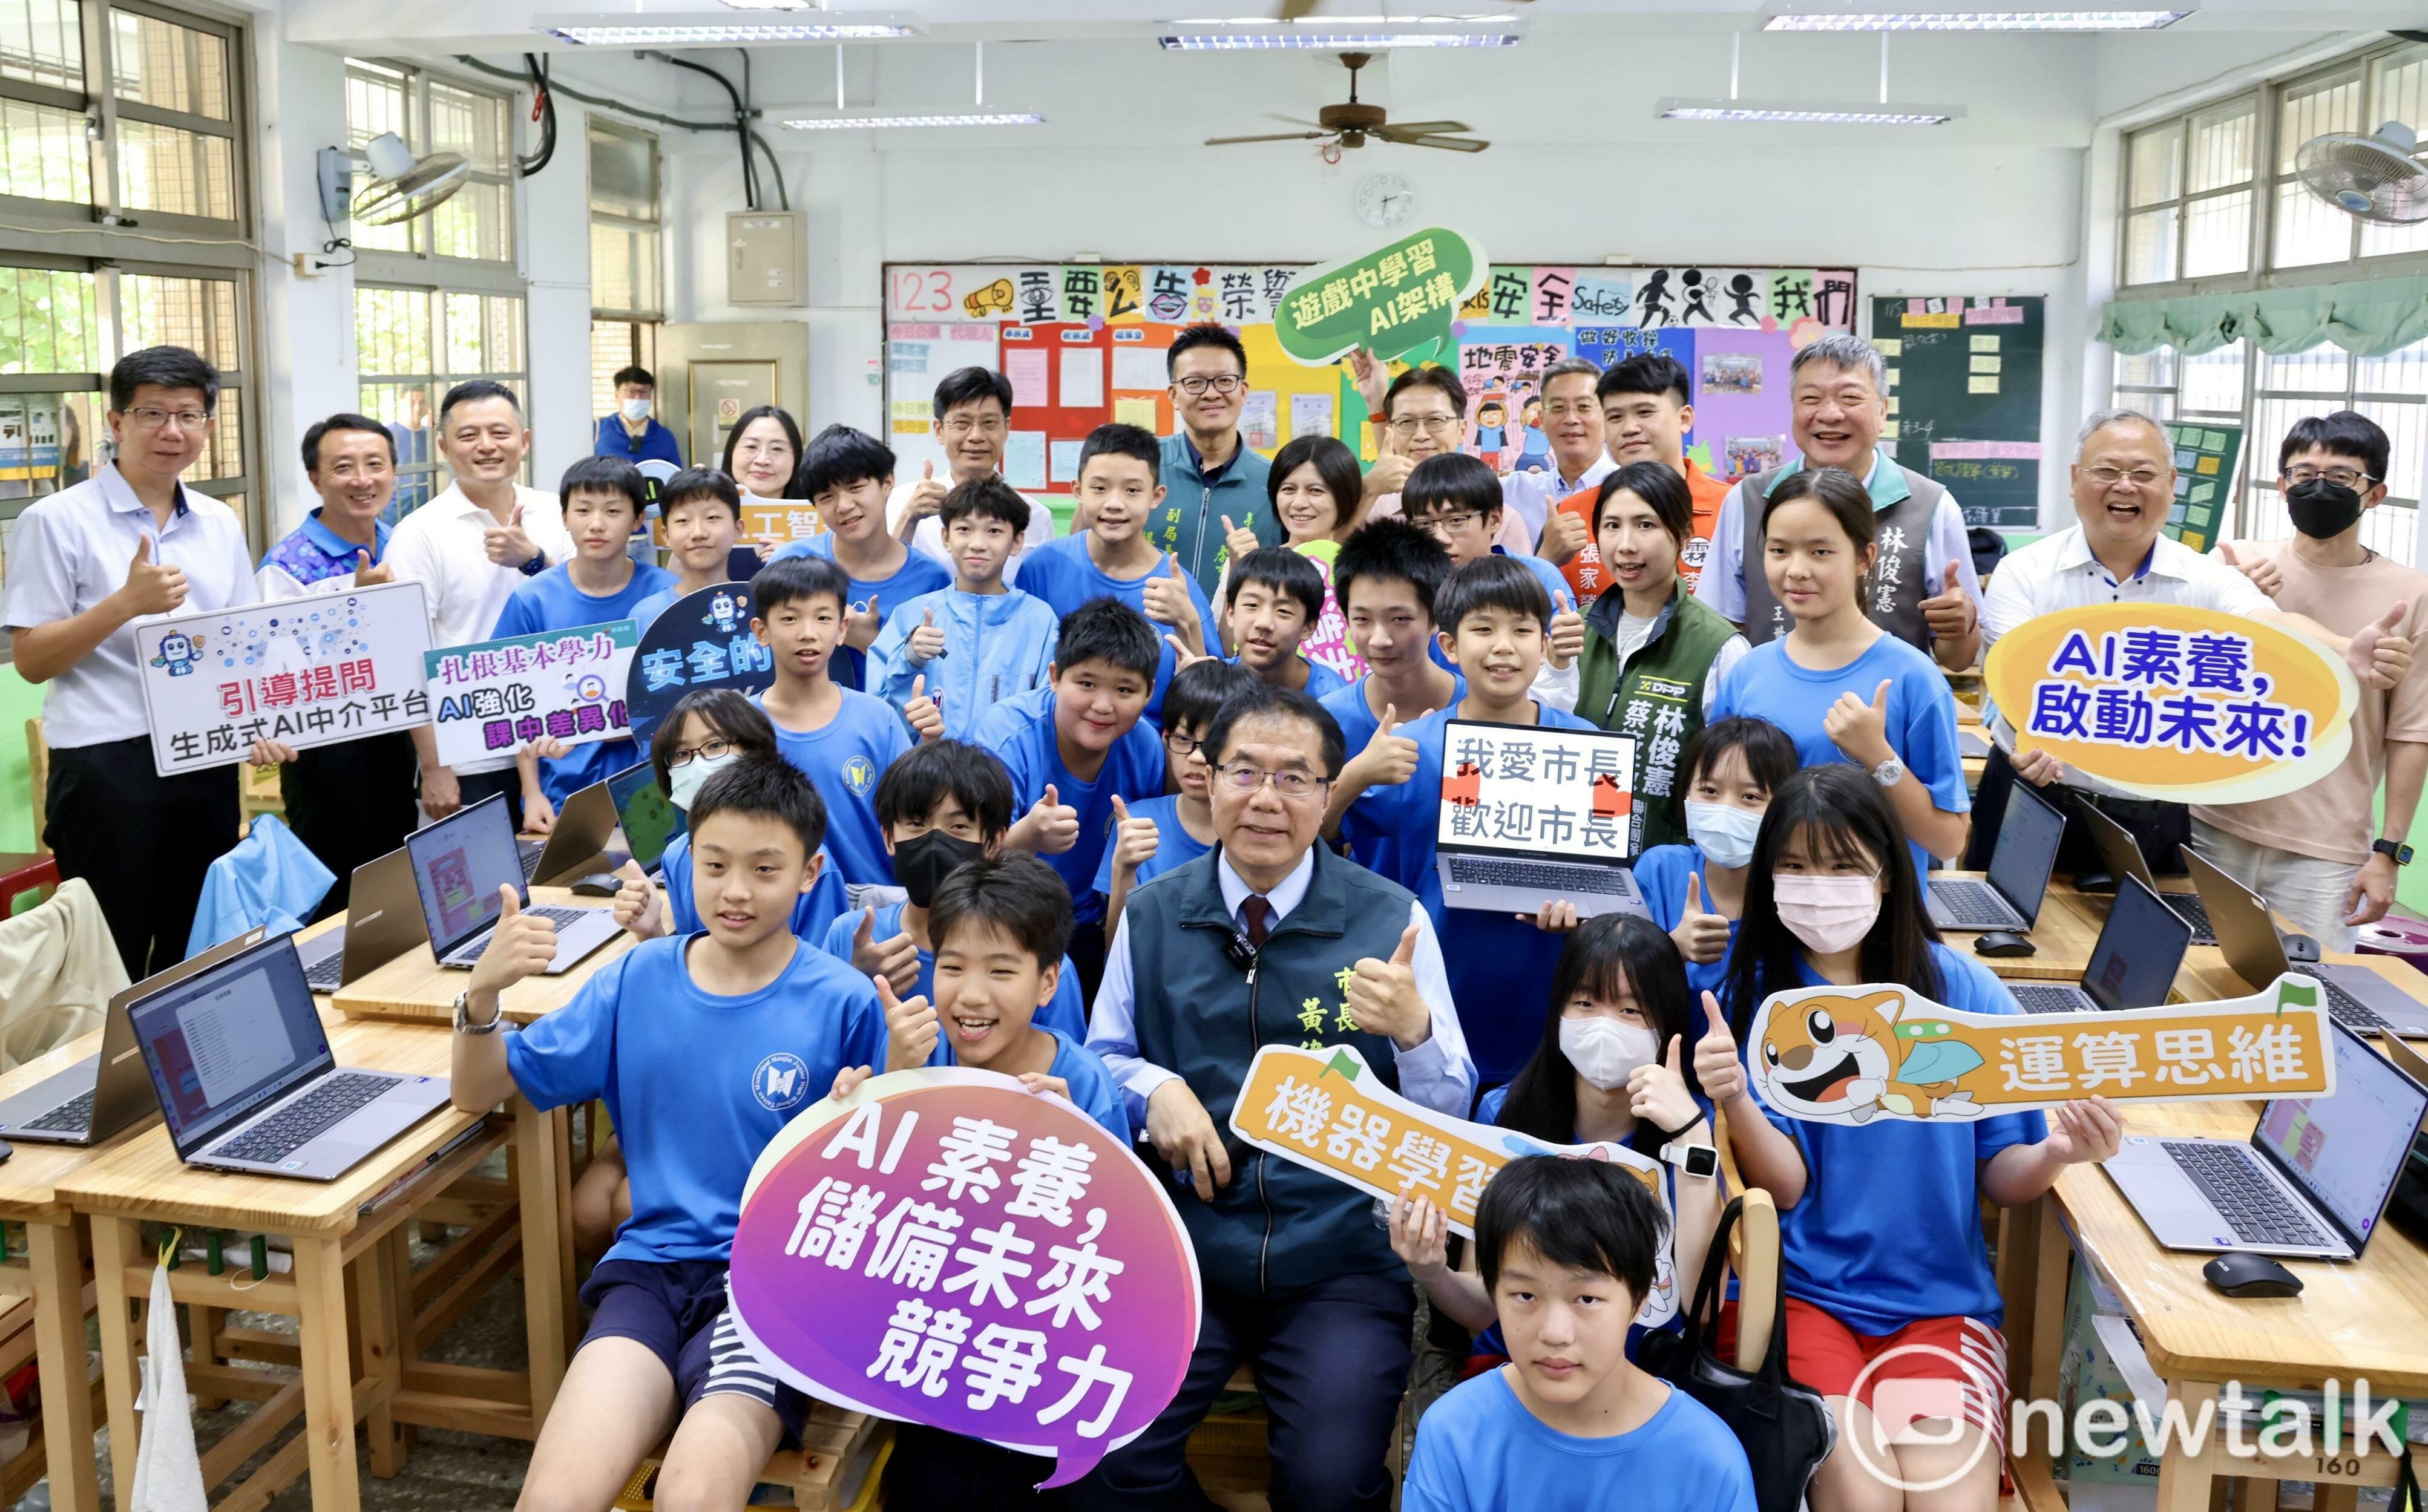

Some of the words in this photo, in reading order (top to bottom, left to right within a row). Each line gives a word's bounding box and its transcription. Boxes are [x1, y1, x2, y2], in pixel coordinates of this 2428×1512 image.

[893, 271, 953, 312] 123
[1290, 238, 1437, 330] 遊戲中學習
[1371, 272, 1457, 336] AI架構
[1493, 272, 1570, 321] 安全
[1572, 286, 1630, 316] Safety
[1773, 275, 1853, 326] 我們
[1465, 344, 1561, 370] 地震安全
[741, 509, 831, 539] 工智
[1876, 526, 1909, 614] 林俊憲
[219, 658, 376, 716] 引導提問
[441, 635, 614, 686] 扎根基本學力
[642, 632, 772, 692] 安全的
[1652, 682, 1686, 696] DPP
[2052, 630, 2274, 696] AI素養,
[170, 689, 429, 764] 生成式AI中介平台
[438, 683, 534, 723] AI強化
[483, 699, 630, 751] 課中差異化
[2032, 684, 2308, 758] 啟動未來!
[1455, 738, 1622, 789] 我愛市長
[1642, 704, 1687, 798] 林俊憲
[1451, 796, 1618, 849] 歡迎市長
[1334, 966, 1360, 1033] 市長
[2000, 1023, 2309, 1091] 運算思維
[1265, 1075, 1500, 1210] 機器學習
[821, 1101, 920, 1176] AI
[924, 1115, 1109, 1245] 素養,
[784, 1176, 1125, 1332] 儲備未來
[865, 1297, 1135, 1439] 競爭力
[2316, 1457, 2360, 1476] 160
